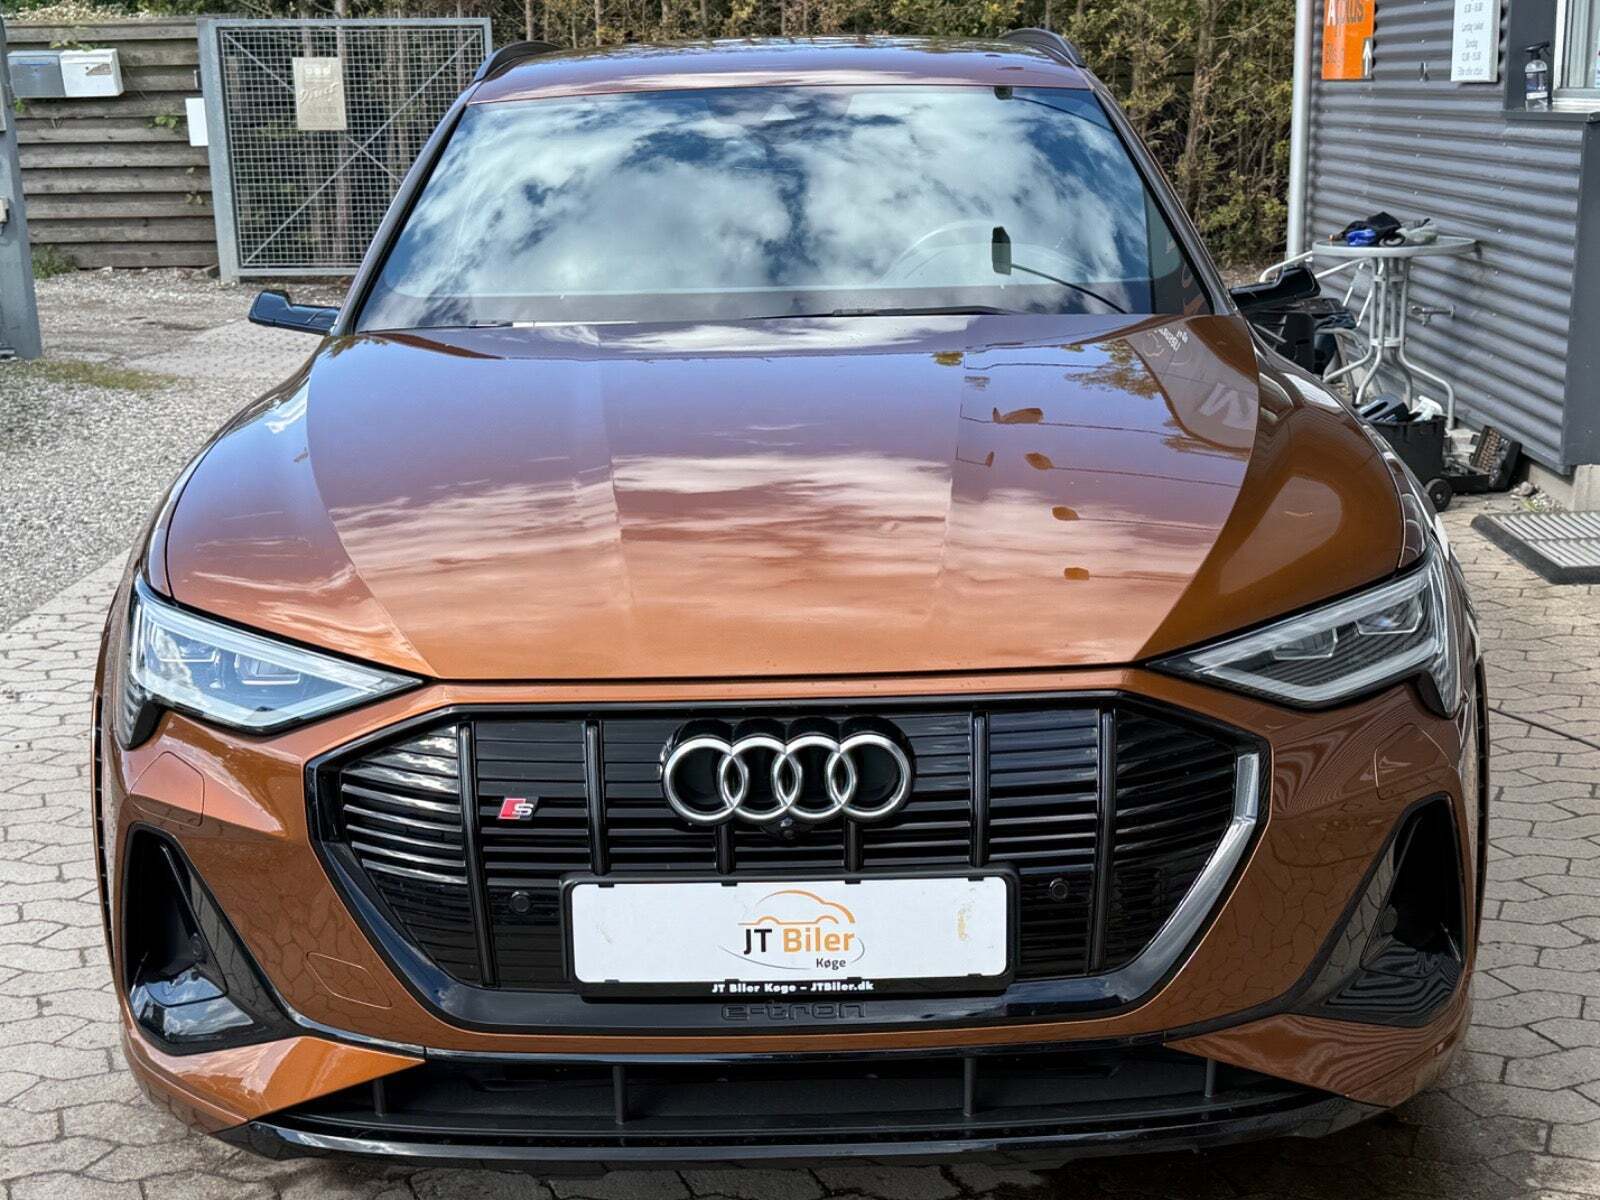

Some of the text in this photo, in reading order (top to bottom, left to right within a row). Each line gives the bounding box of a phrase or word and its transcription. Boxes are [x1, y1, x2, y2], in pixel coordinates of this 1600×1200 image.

[744, 927, 855, 955] JT Biler
[816, 958, 847, 971] Køge
[712, 984, 725, 993] JT
[729, 983, 760, 993] Biler
[810, 981, 874, 992] JTBiler.dk
[721, 1002, 866, 1021] e-tron
